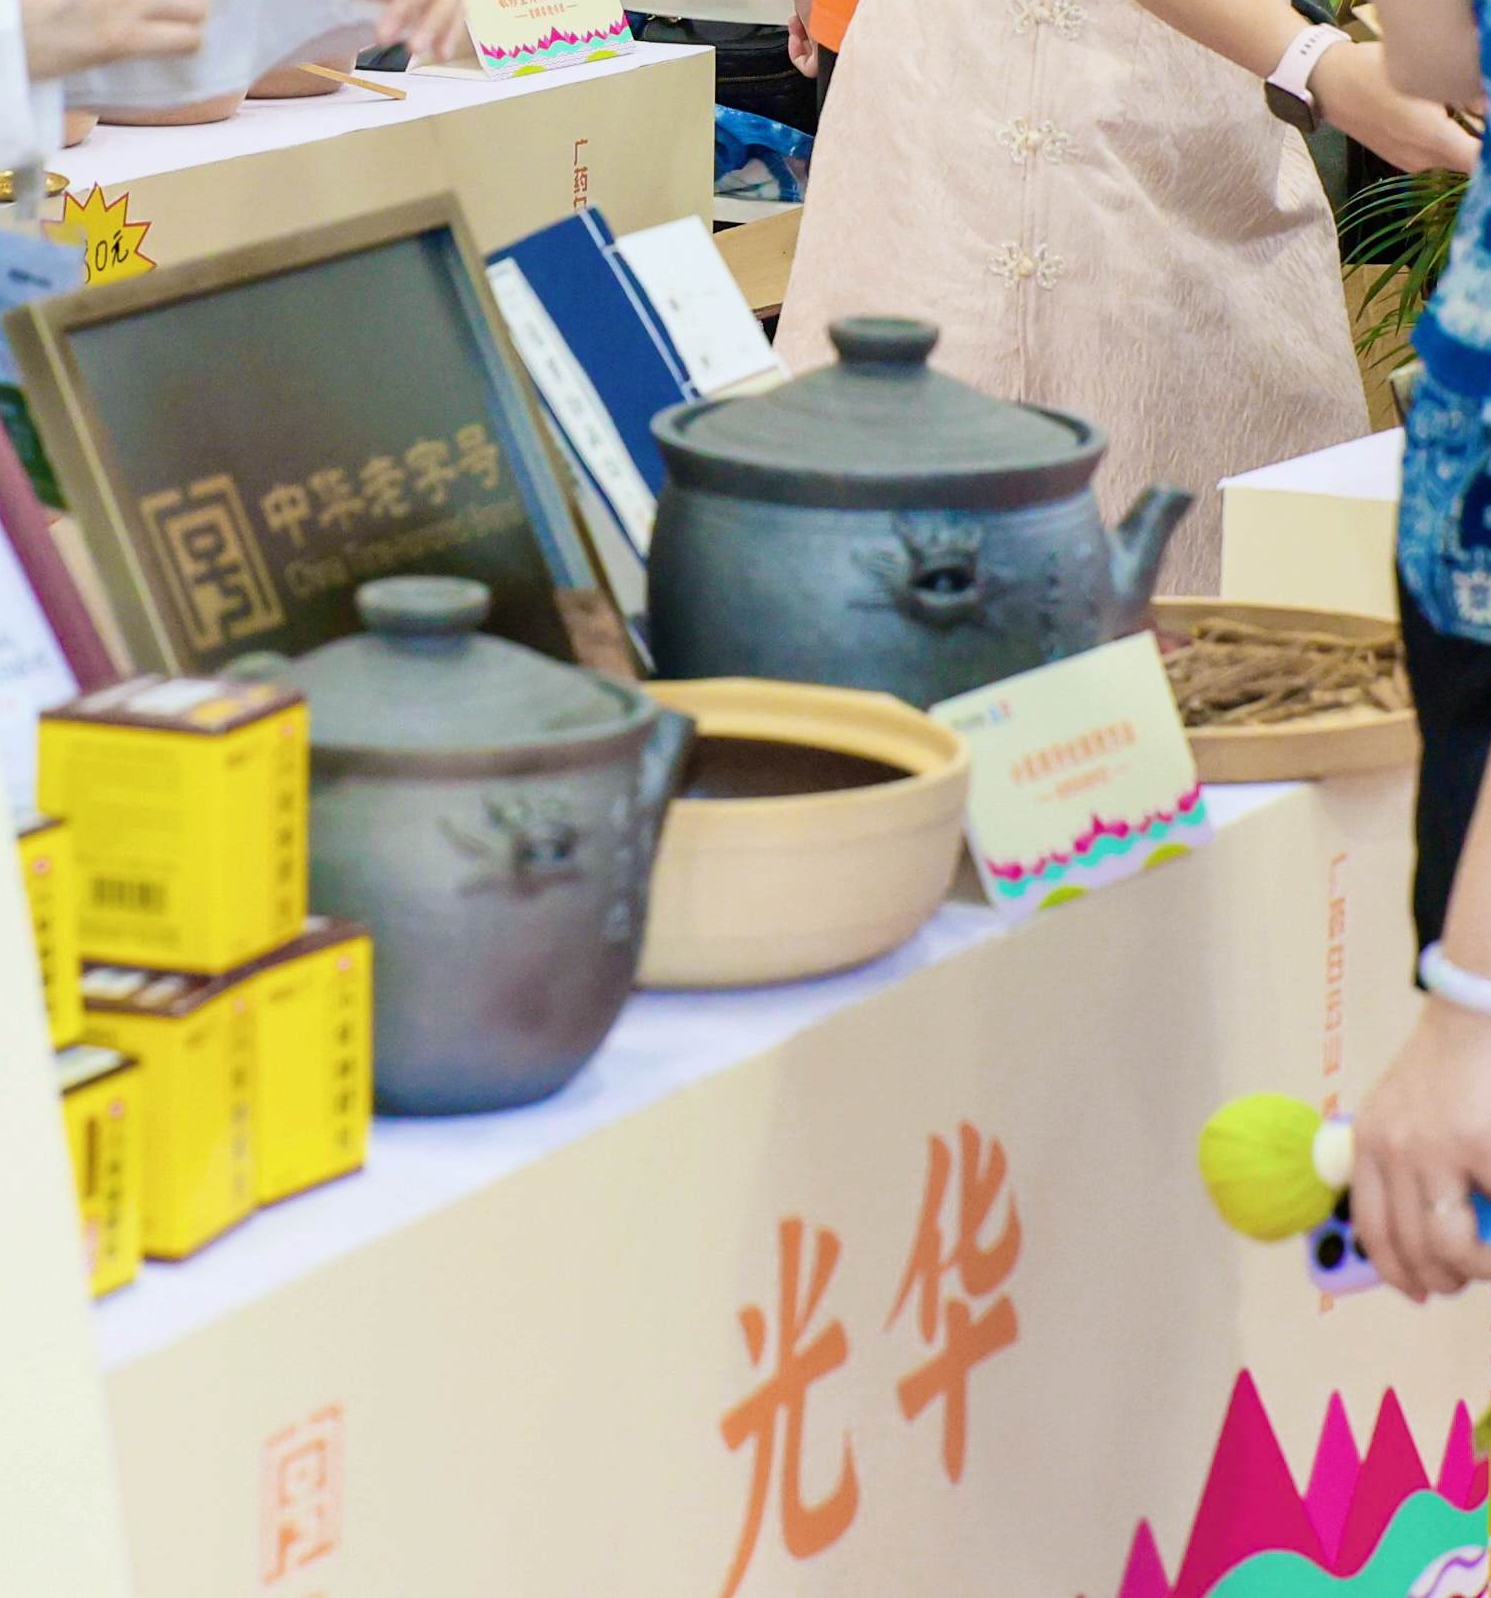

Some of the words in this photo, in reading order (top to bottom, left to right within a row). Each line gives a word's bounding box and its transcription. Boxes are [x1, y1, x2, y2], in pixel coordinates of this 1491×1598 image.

[261, 422, 500, 548] 中华老字号
[719, 1120, 1023, 1598] 光华
